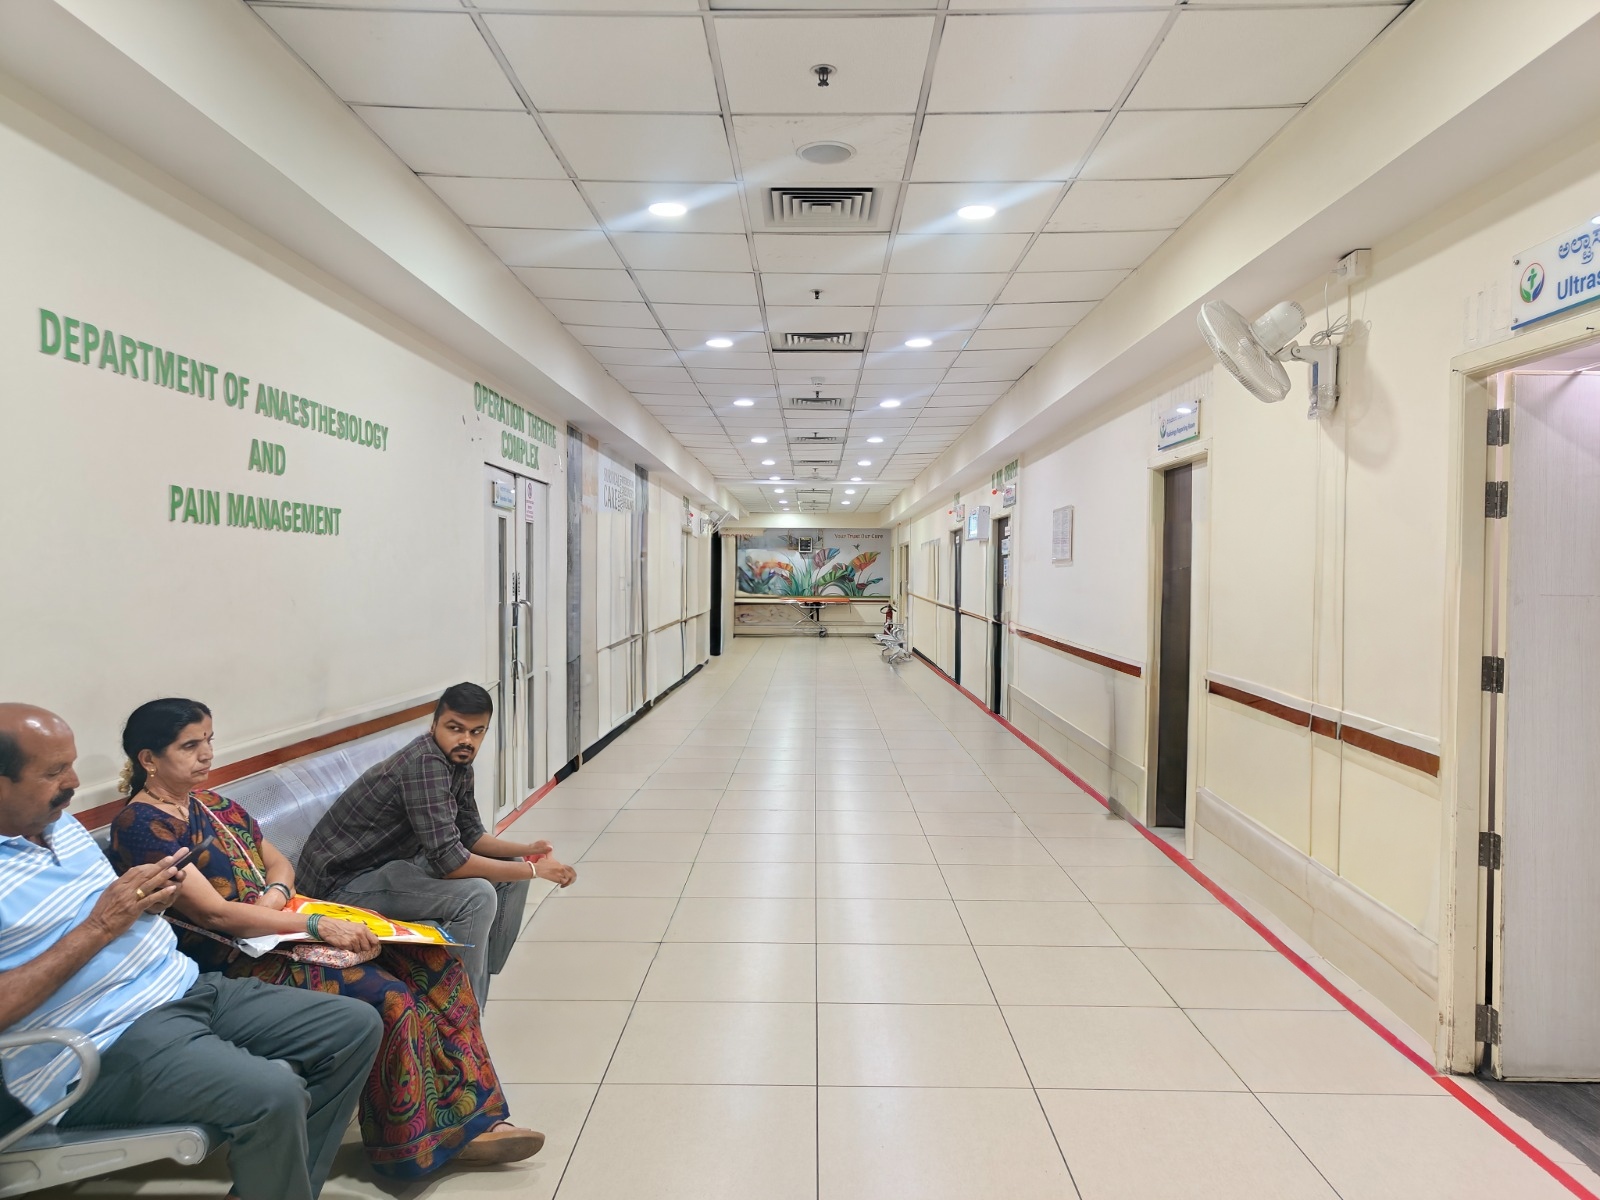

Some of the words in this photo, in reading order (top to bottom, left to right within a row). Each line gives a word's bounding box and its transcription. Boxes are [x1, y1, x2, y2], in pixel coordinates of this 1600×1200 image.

[39, 308, 218, 400] DEPARTMENT
[223, 371, 250, 409] OF
[254, 383, 389, 451] ANAESTHESIOLOGY
[473, 381, 524, 433] OPERATION
[527, 411, 556, 449] THEATRE
[248, 438, 287, 476] AND
[501, 430, 540, 470] COMPLEX
[169, 484, 221, 526] PAIN
[227, 492, 342, 535] MANAGEMENT
[603, 484, 618, 510] CARE
